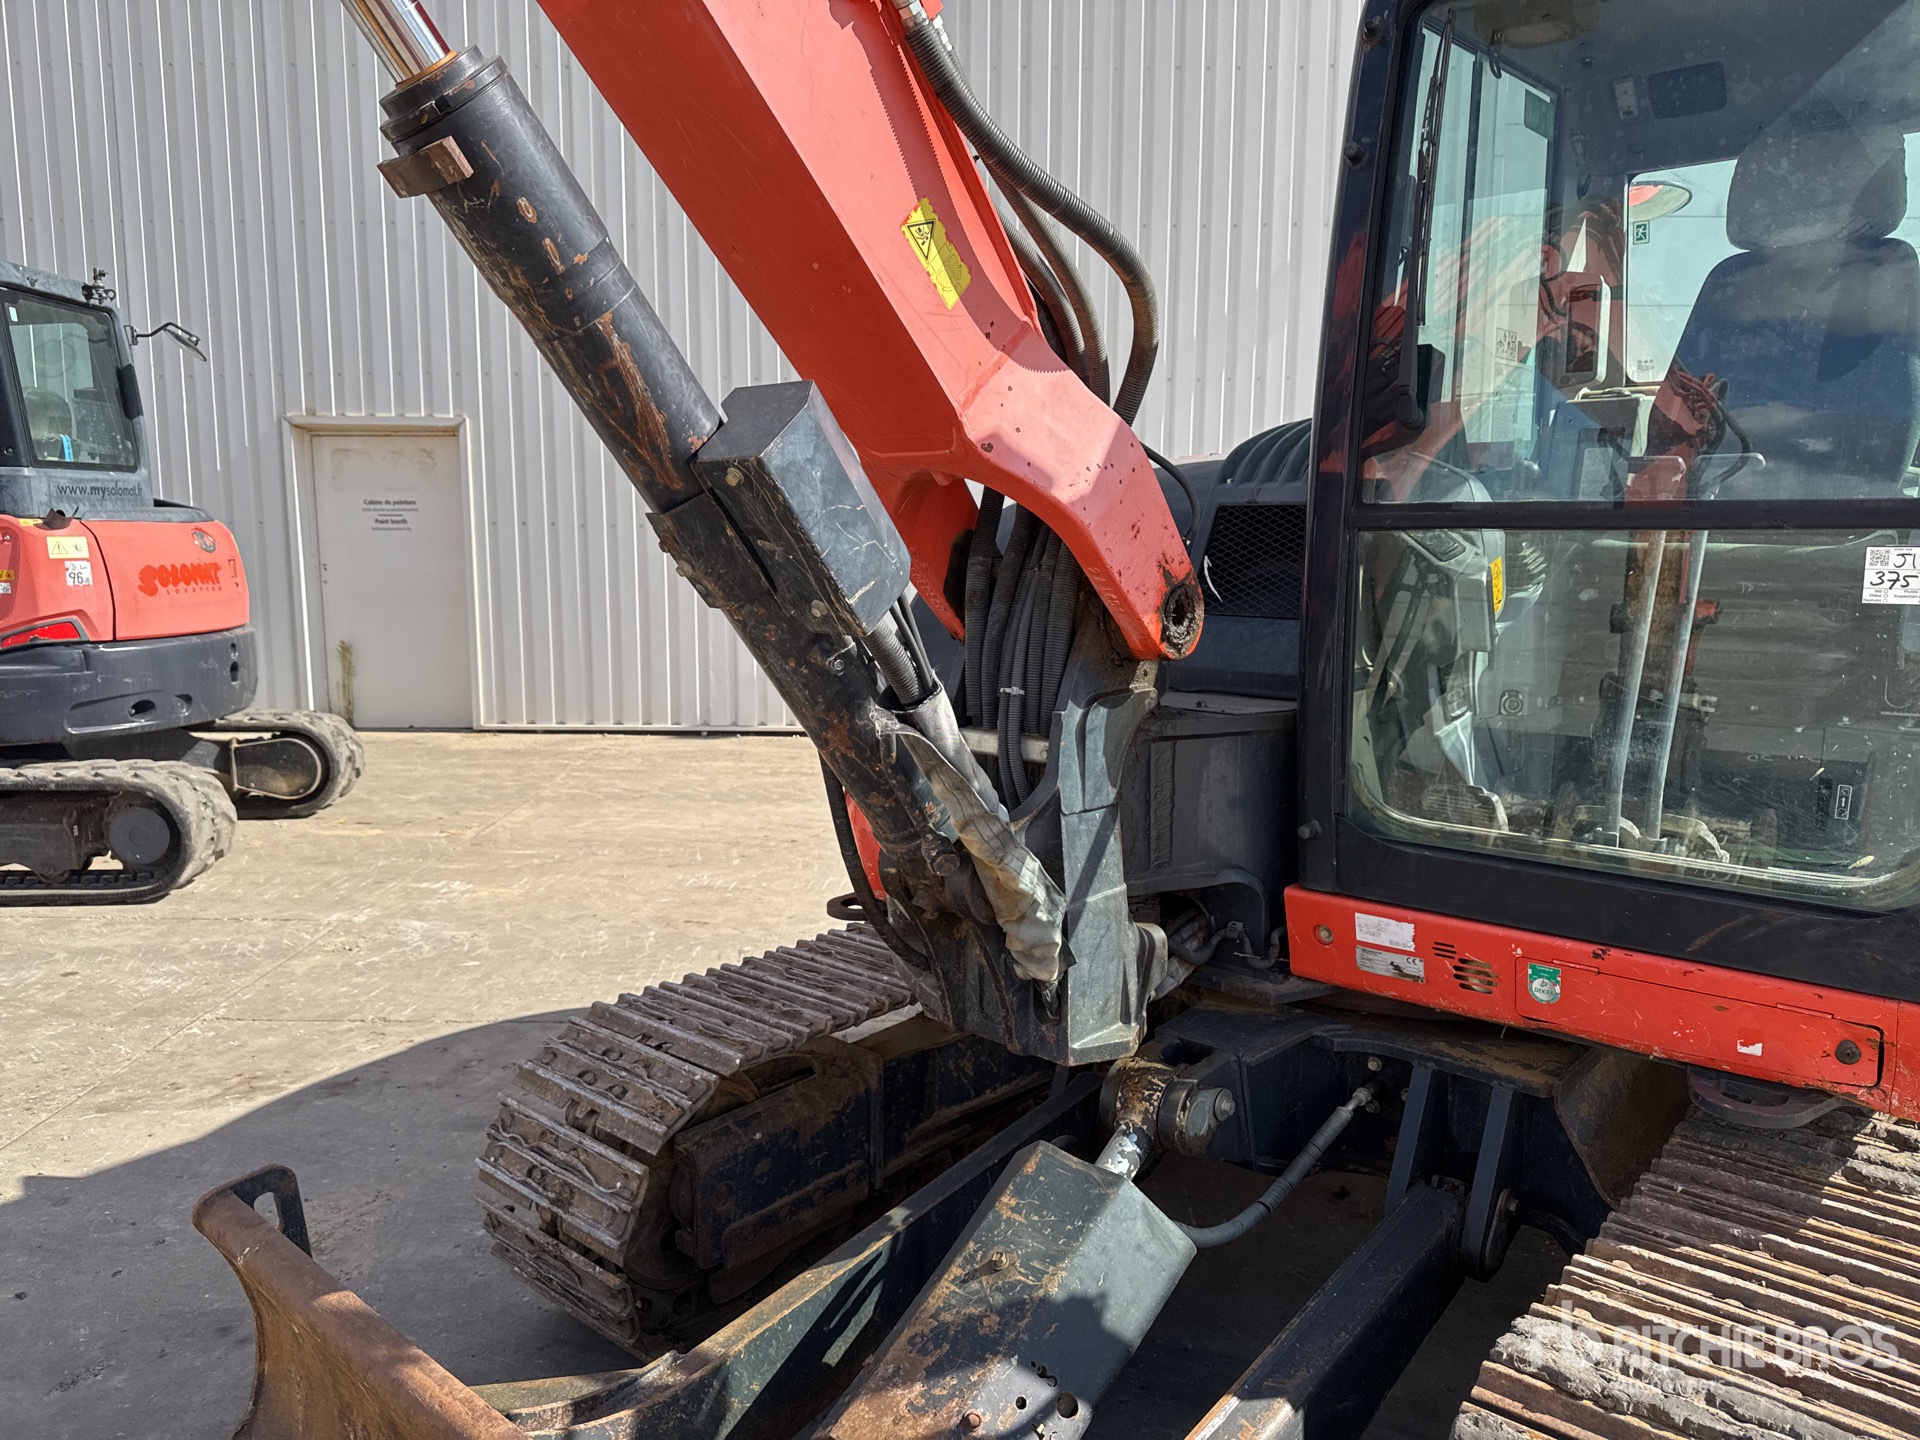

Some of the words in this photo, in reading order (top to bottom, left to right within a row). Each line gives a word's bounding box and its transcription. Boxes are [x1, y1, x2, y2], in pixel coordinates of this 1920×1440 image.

[68, 572, 84, 584] 96
[138, 563, 221, 597] SOLOMAT
[1870, 571, 1919, 590] 375
[1406, 956, 1418, 966] CE
[1534, 987, 1554, 997] DEKRA
